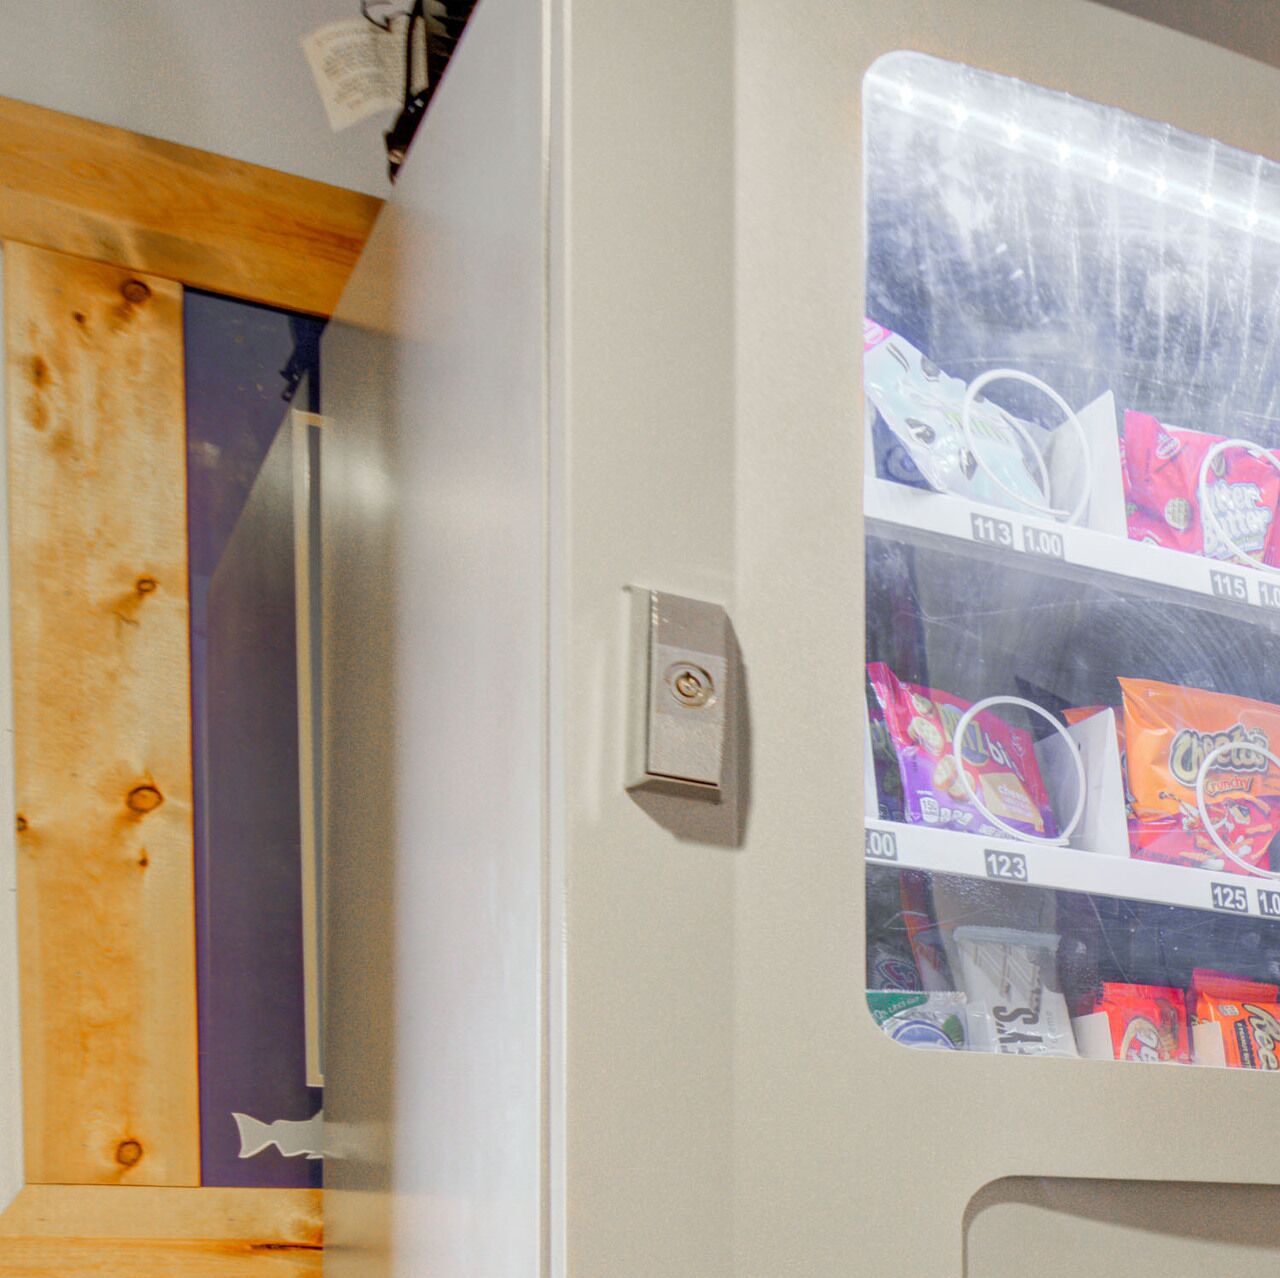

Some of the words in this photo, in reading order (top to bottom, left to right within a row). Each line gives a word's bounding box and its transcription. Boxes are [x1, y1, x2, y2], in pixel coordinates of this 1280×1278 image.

[974, 516, 1011, 545] 113
[1025, 529, 1063, 558] 1.00
[1214, 574, 1246, 598] 115
[988, 854, 1026, 879] 123
[1214, 888, 1246, 911] 125
